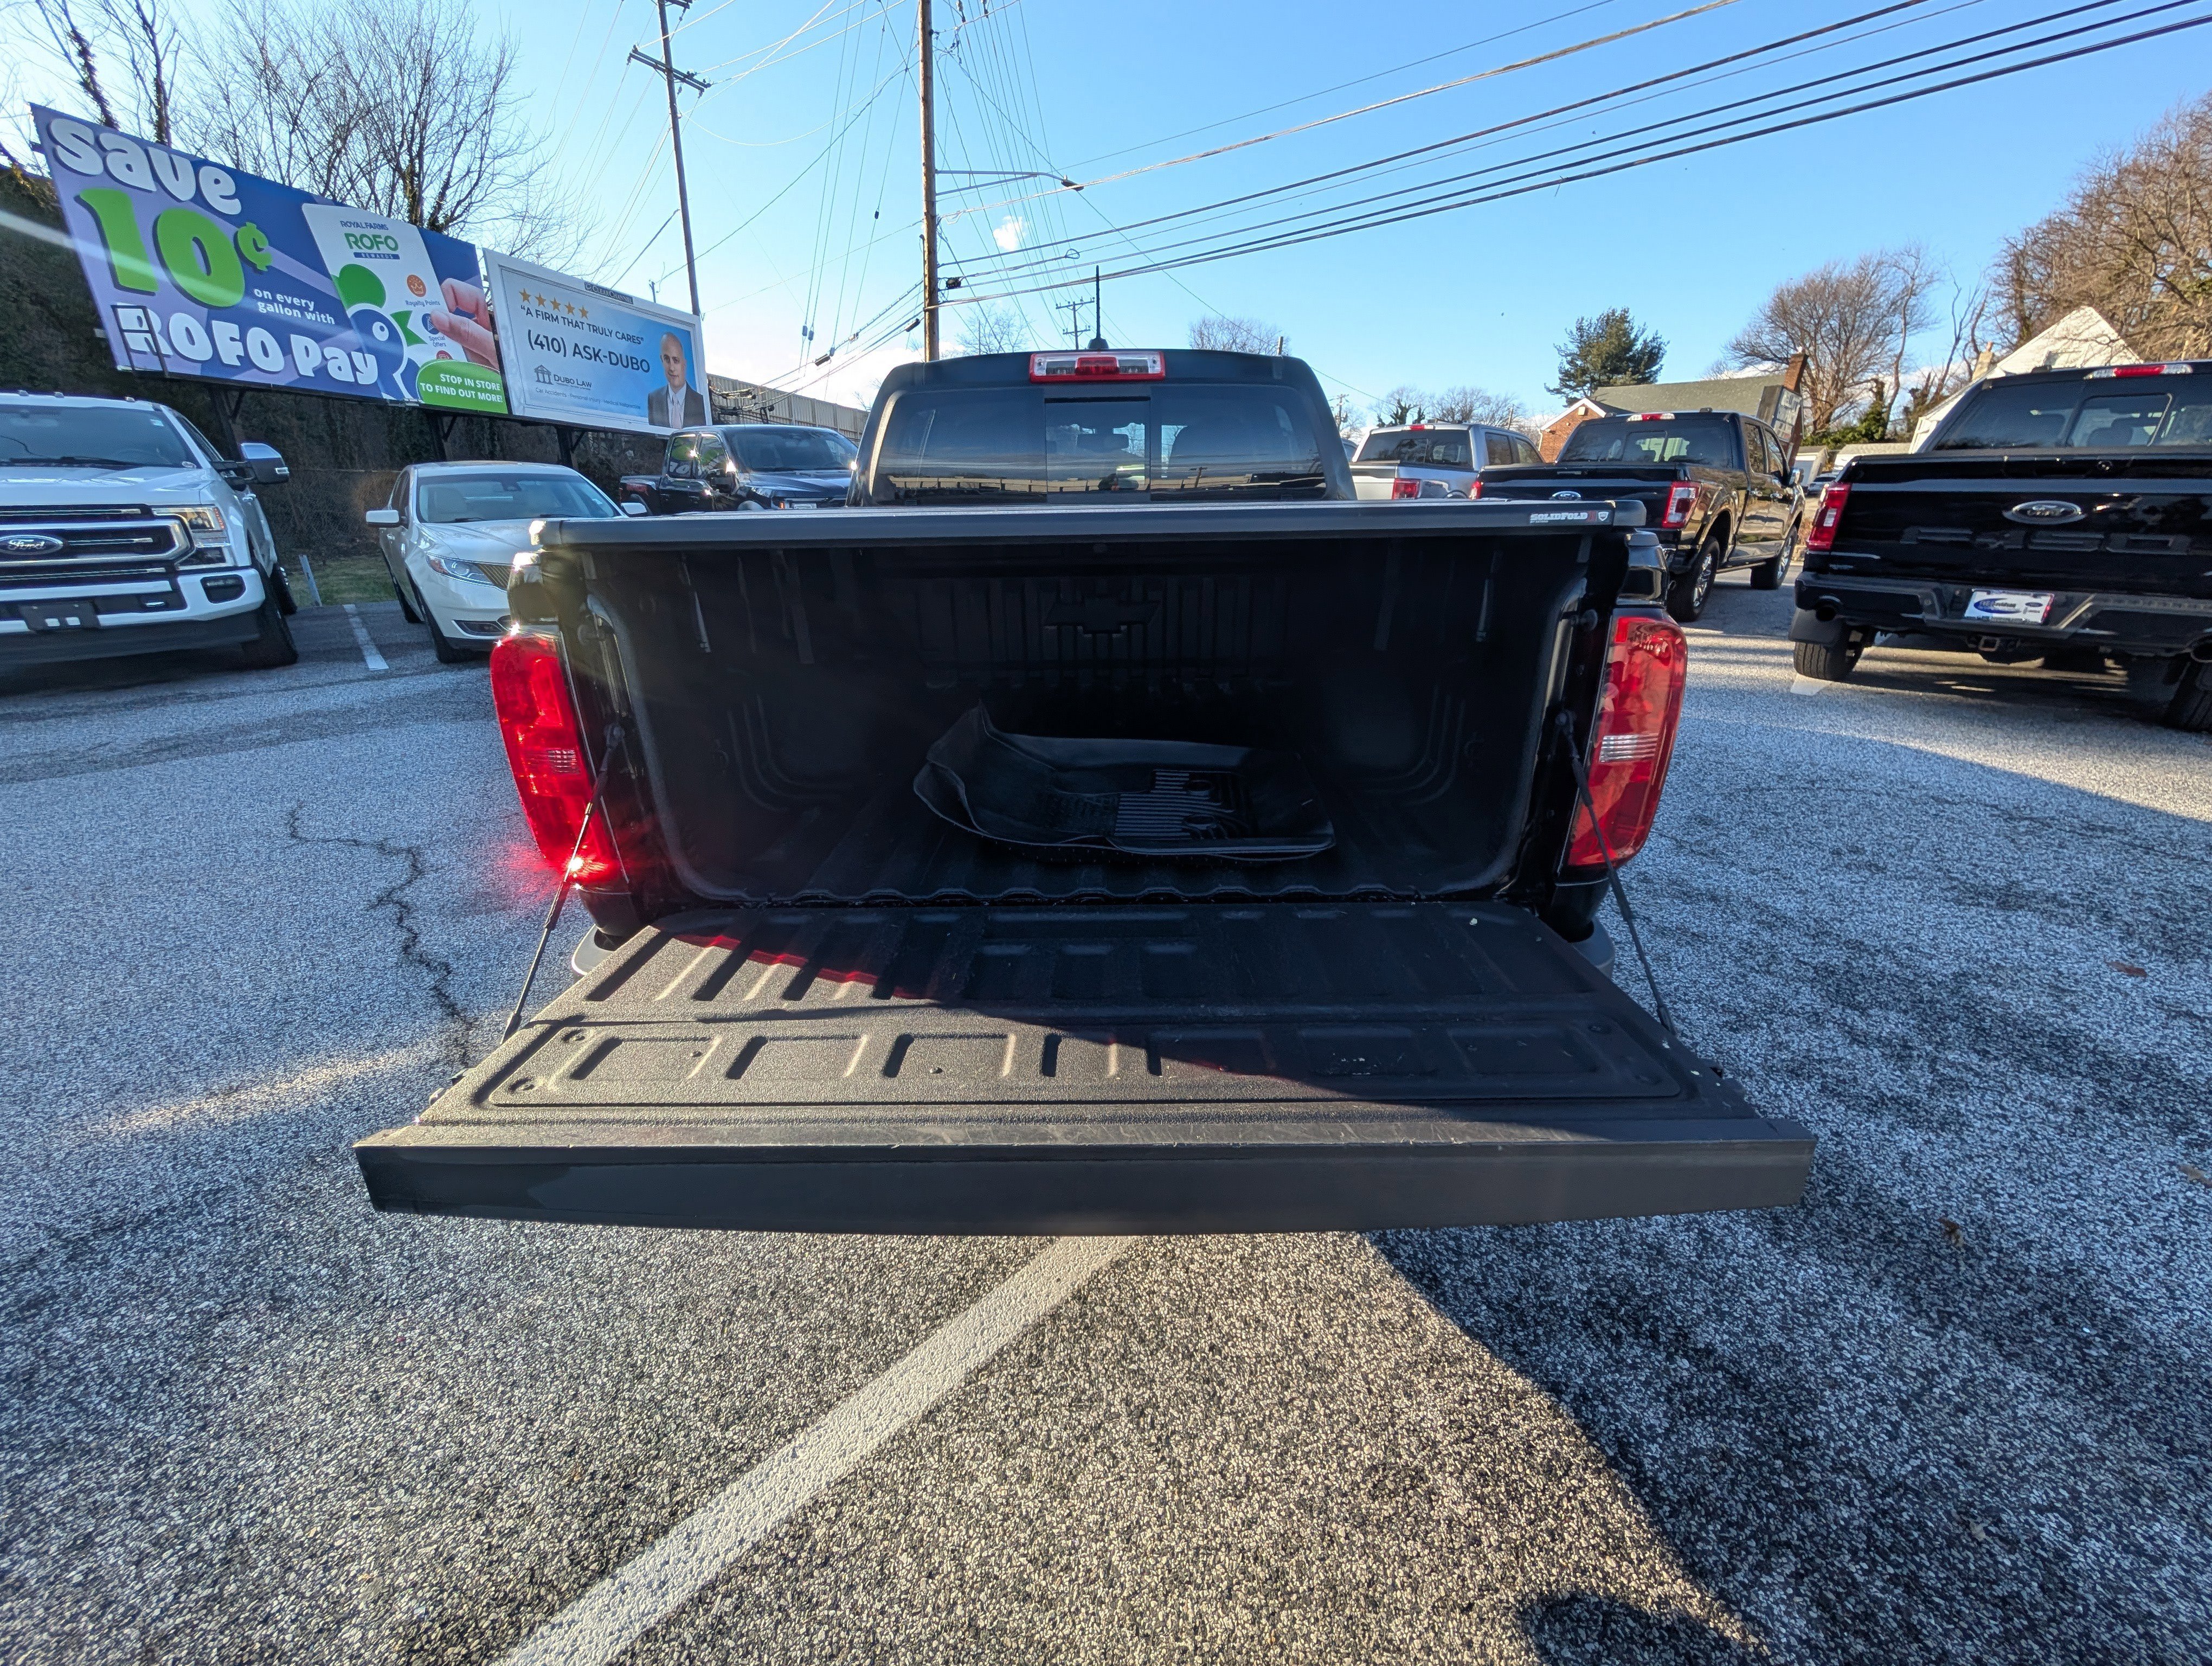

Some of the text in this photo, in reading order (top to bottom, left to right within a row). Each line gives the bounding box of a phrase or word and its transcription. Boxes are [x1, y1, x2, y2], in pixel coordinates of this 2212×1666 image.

[344, 233, 399, 251] ROFO
[254, 288, 314, 311] on every
[258, 301, 335, 325] gallon with
[535, 309, 560, 324] FIRM
[561, 316, 585, 330] THAT
[586, 323, 613, 338] TRULY
[114, 302, 378, 385] ROFO Pay
[528, 329, 651, 373] (410) ASK-DUBO
[440, 373, 500, 390] STOP IN STORE
[553, 374, 575, 385] DUBO
[576, 378, 592, 388] LAW
[420, 382, 503, 403] TO FIND OUT MORE!
[7, 539, 46, 550] Ford
